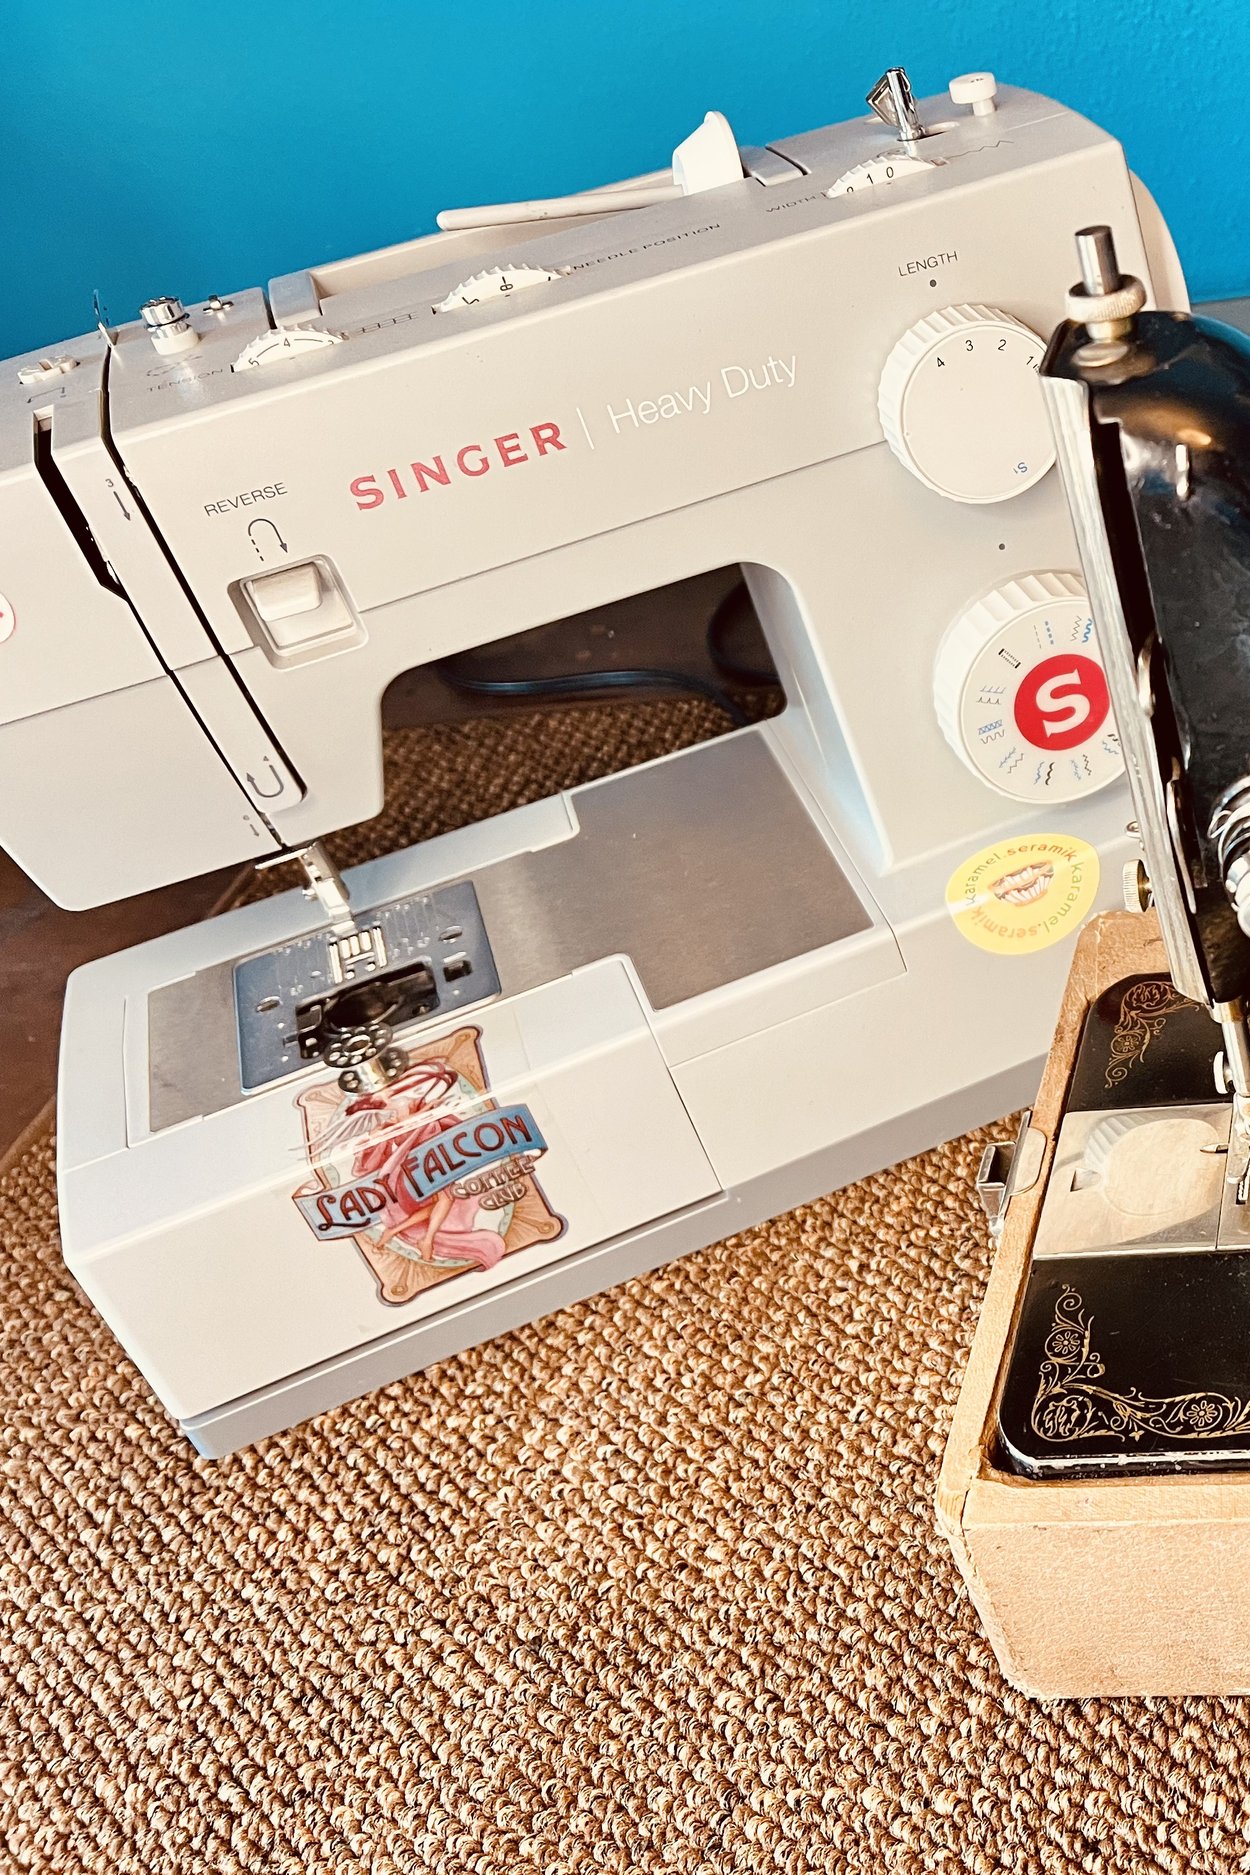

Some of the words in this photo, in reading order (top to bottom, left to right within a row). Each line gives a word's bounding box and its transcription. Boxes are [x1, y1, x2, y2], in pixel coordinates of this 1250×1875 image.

[885, 166, 895, 179] 0
[766, 194, 817, 213] WIDTH
[572, 248, 638, 271] NEEDLE
[643, 223, 721, 250] POSITION
[898, 250, 959, 277] LENGTH
[283, 337, 291, 348] 4
[936, 356, 946, 369] 4
[965, 339, 974, 352] 3
[997, 338, 1007, 352] 2
[349, 422, 567, 511] SINGER
[606, 380, 711, 434] Heavy
[720, 355, 797, 399] Duty
[203, 481, 288, 517] REVERSE
[1035, 667, 1091, 738] S
[315, 1172, 399, 1232] LADY
[400, 1114, 533, 1198] FALCON
